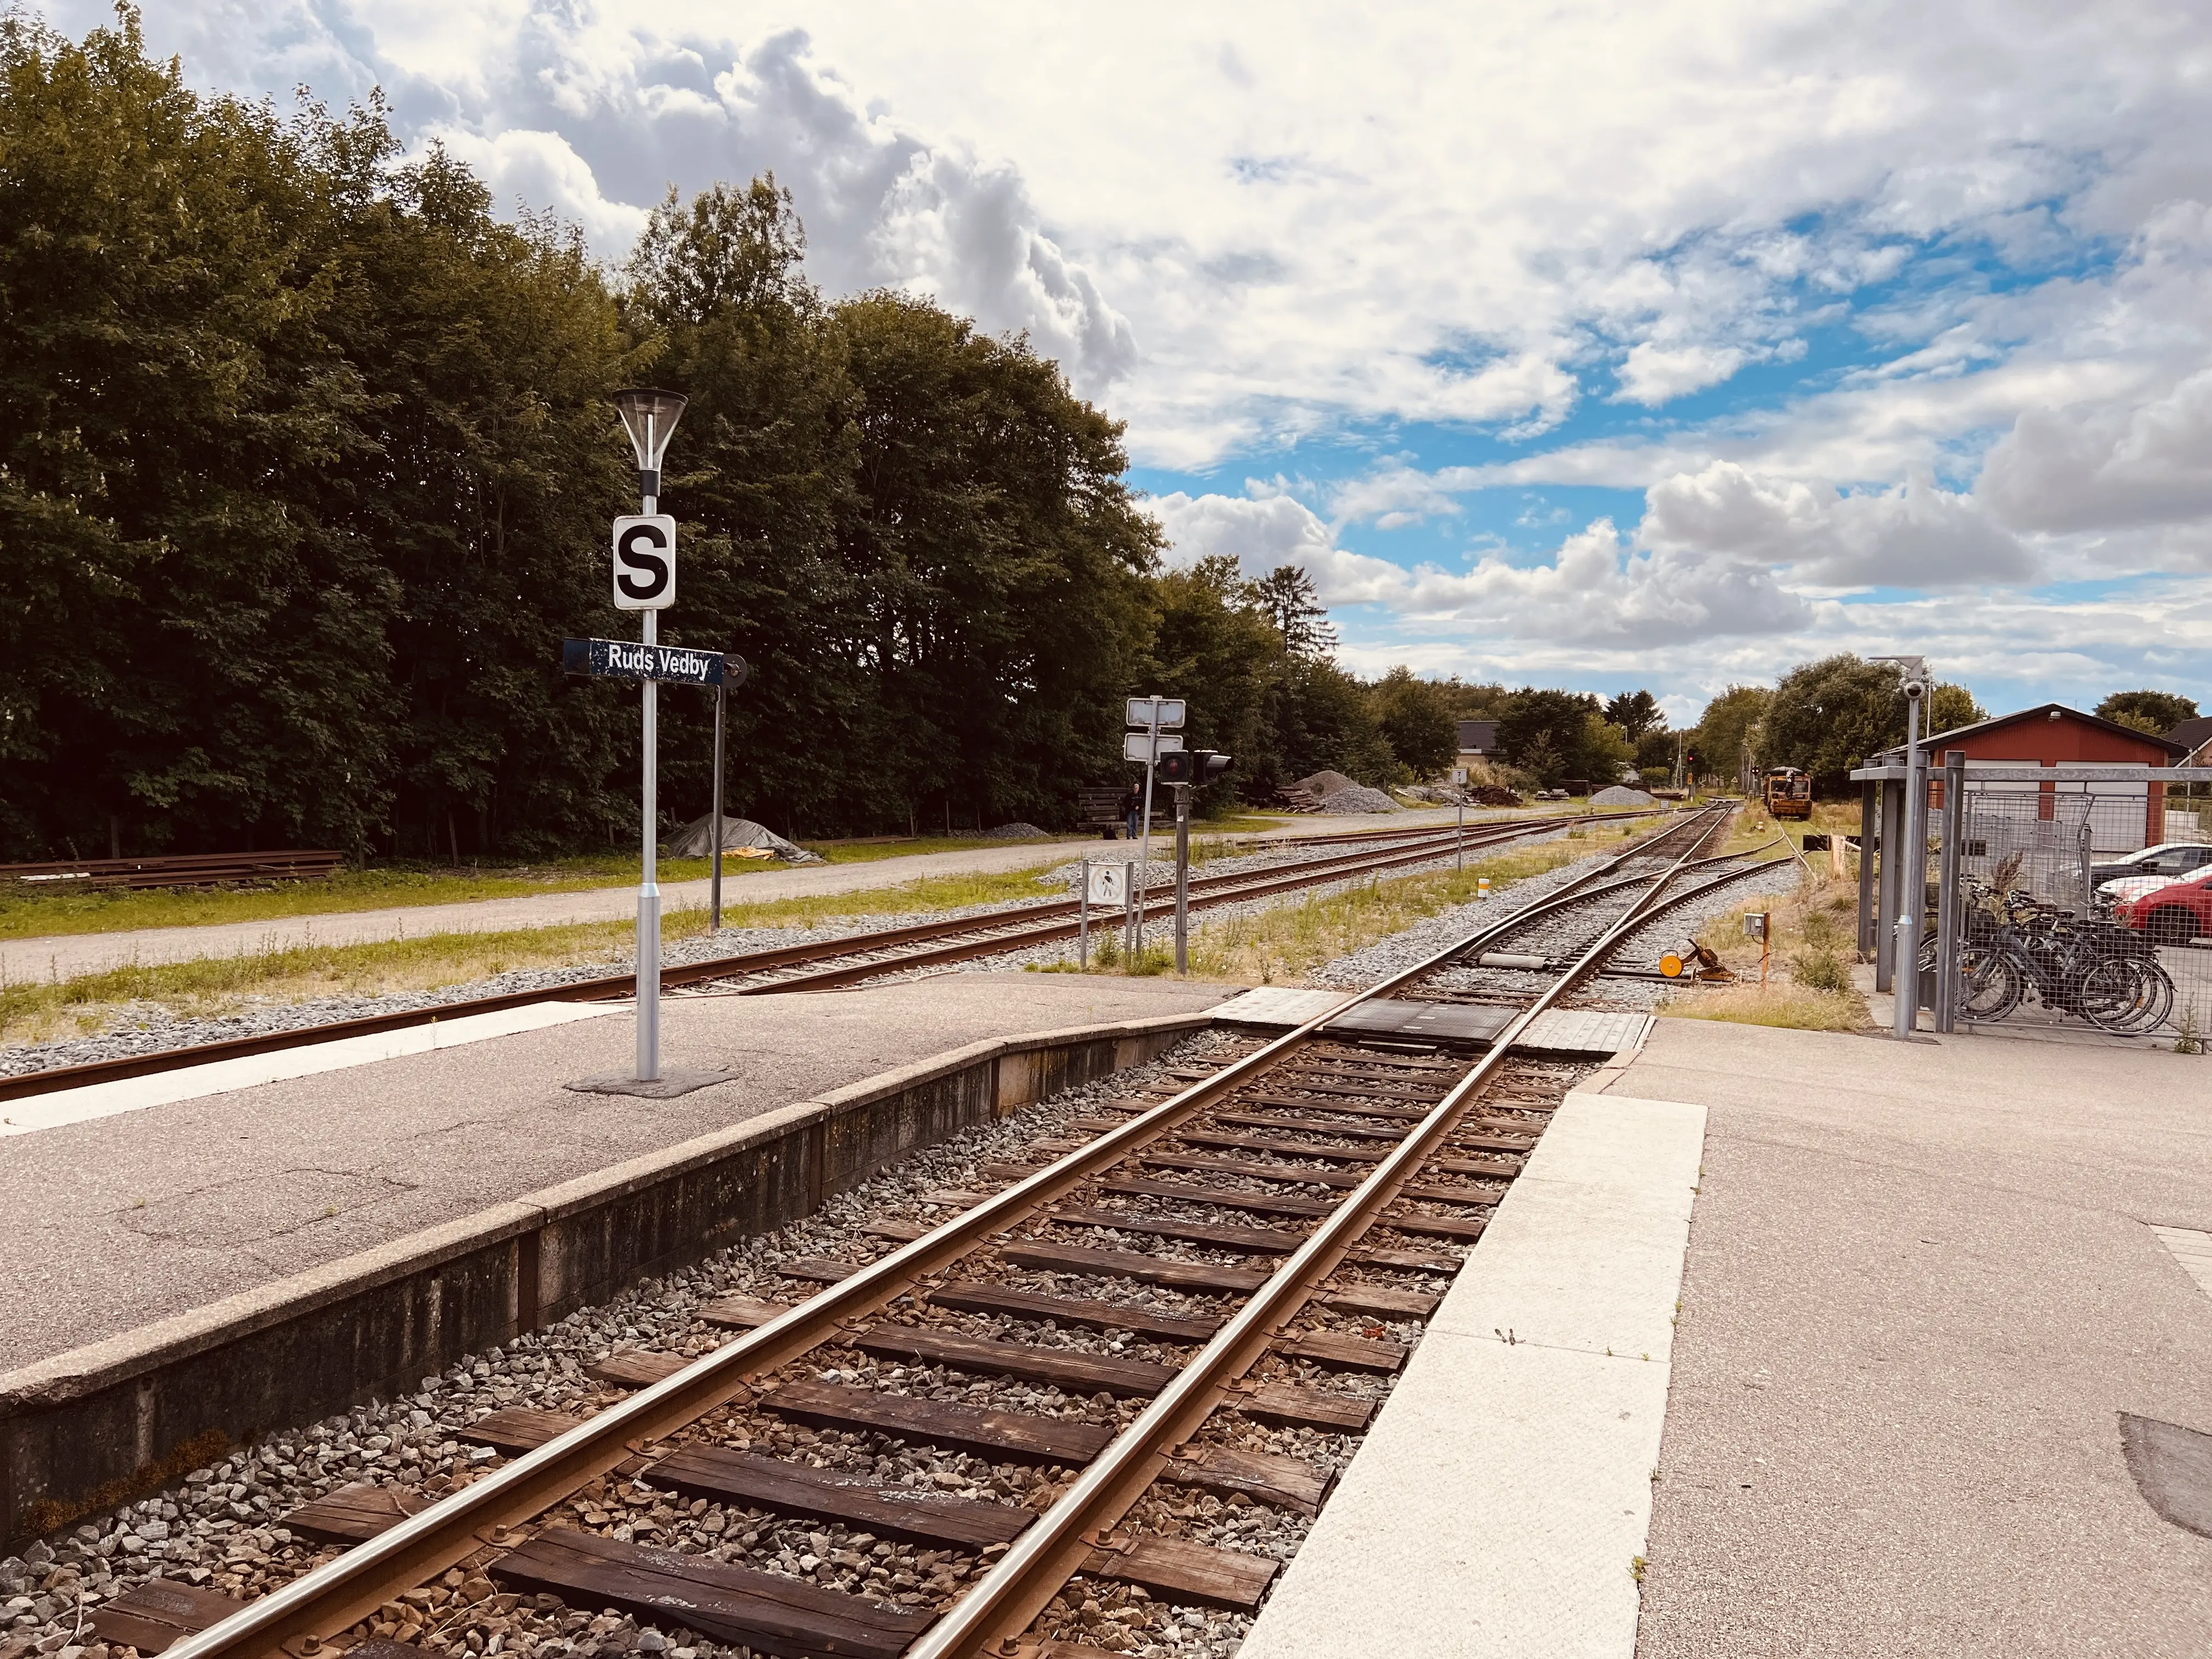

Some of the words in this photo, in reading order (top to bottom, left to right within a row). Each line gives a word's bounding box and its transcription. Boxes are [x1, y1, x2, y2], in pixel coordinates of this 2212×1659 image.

[617, 524, 668, 600] S
[608, 644, 654, 672] Ruds
[659, 650, 709, 681] Vedby
